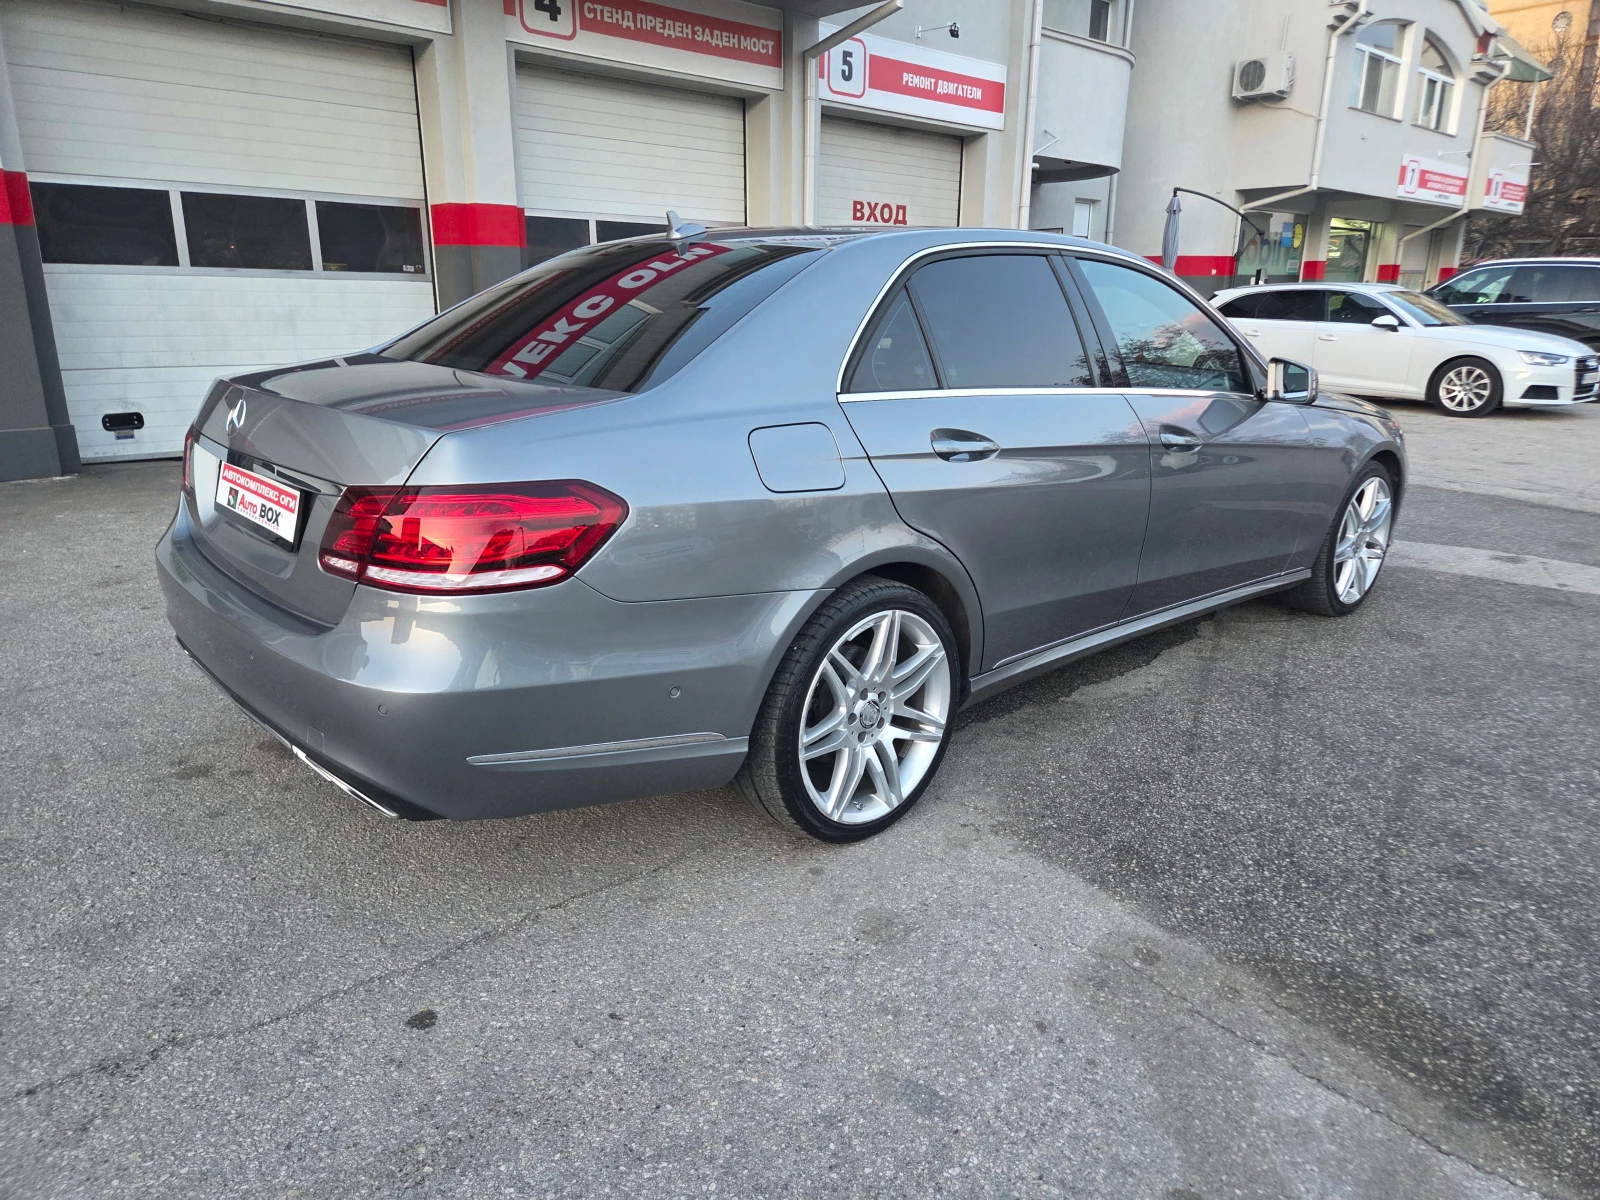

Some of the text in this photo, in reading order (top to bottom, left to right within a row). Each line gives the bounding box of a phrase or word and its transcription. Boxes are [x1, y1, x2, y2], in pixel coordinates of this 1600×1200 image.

[583, 2, 774, 55] СТЕНД ПРЕДЕН ЗАДЕН МОСТ
[841, 50, 853, 82] 5
[902, 72, 982, 101] РЕМОНТ ДВИГАТЕЛИ
[852, 199, 908, 226] ВХОД
[223, 469, 296, 511] АВТОКОМПЛЕКС ОГИ
[259, 502, 281, 527] BOX
